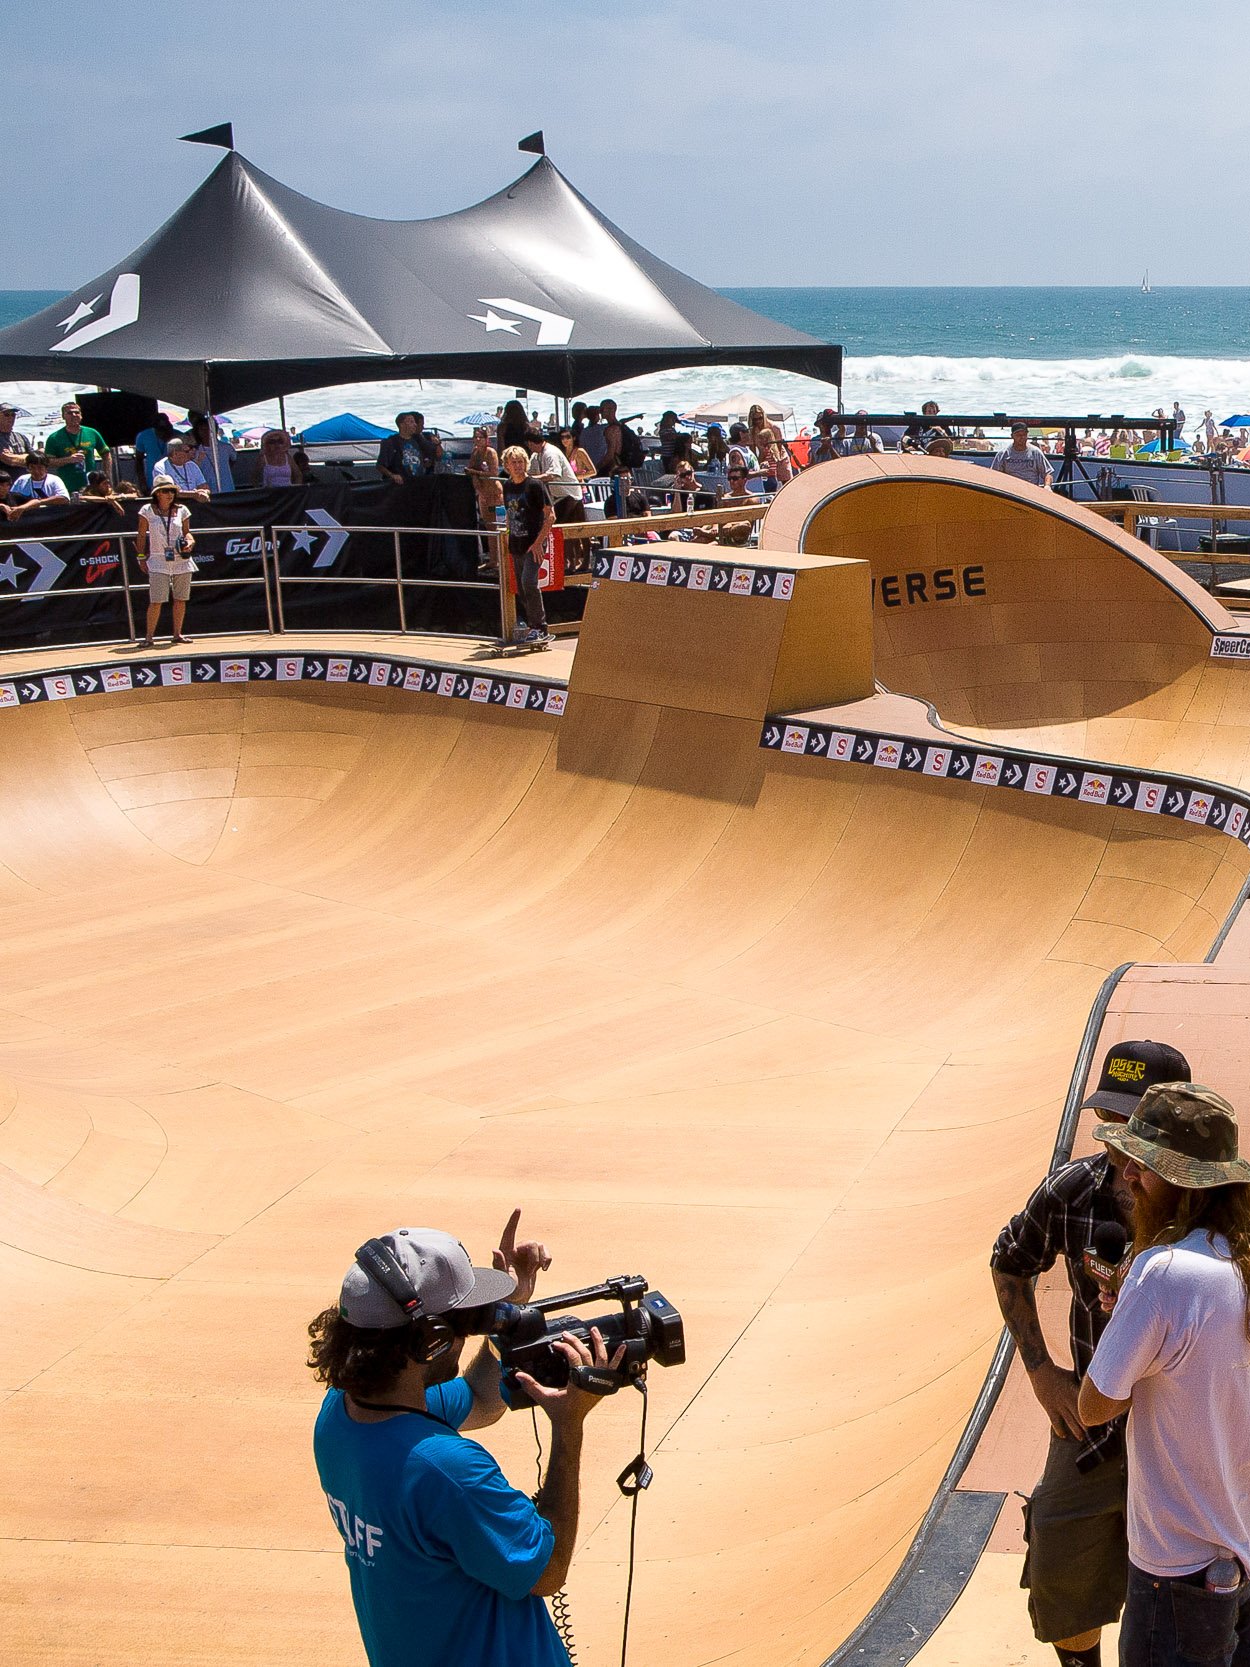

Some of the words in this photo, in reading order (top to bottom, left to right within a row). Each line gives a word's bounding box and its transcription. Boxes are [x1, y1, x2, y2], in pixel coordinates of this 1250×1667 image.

[80, 555, 120, 566] G-SHOCK
[618, 561, 627, 577] S
[697, 570, 705, 585] S
[782, 579, 791, 595] S
[172, 668, 183, 681] S
[286, 663, 297, 676] S
[377, 668, 385, 681] S
[56, 681, 67, 694] S
[119, 678, 130, 686] Bull
[445, 677, 452, 692] S
[514, 688, 523, 704] S
[836, 738, 848, 755] S
[933, 754, 944, 770] S
[1036, 771, 1047, 788] S
[1094, 790, 1105, 798] Bull
[1146, 790, 1159, 807] S
[1198, 810, 1206, 818] Bull
[1232, 811, 1242, 831] S
[1108, 1058, 1146, 1080] LOSER
[1090, 1260, 1111, 1277] FUEL
[327, 1493, 384, 1557] TFF
